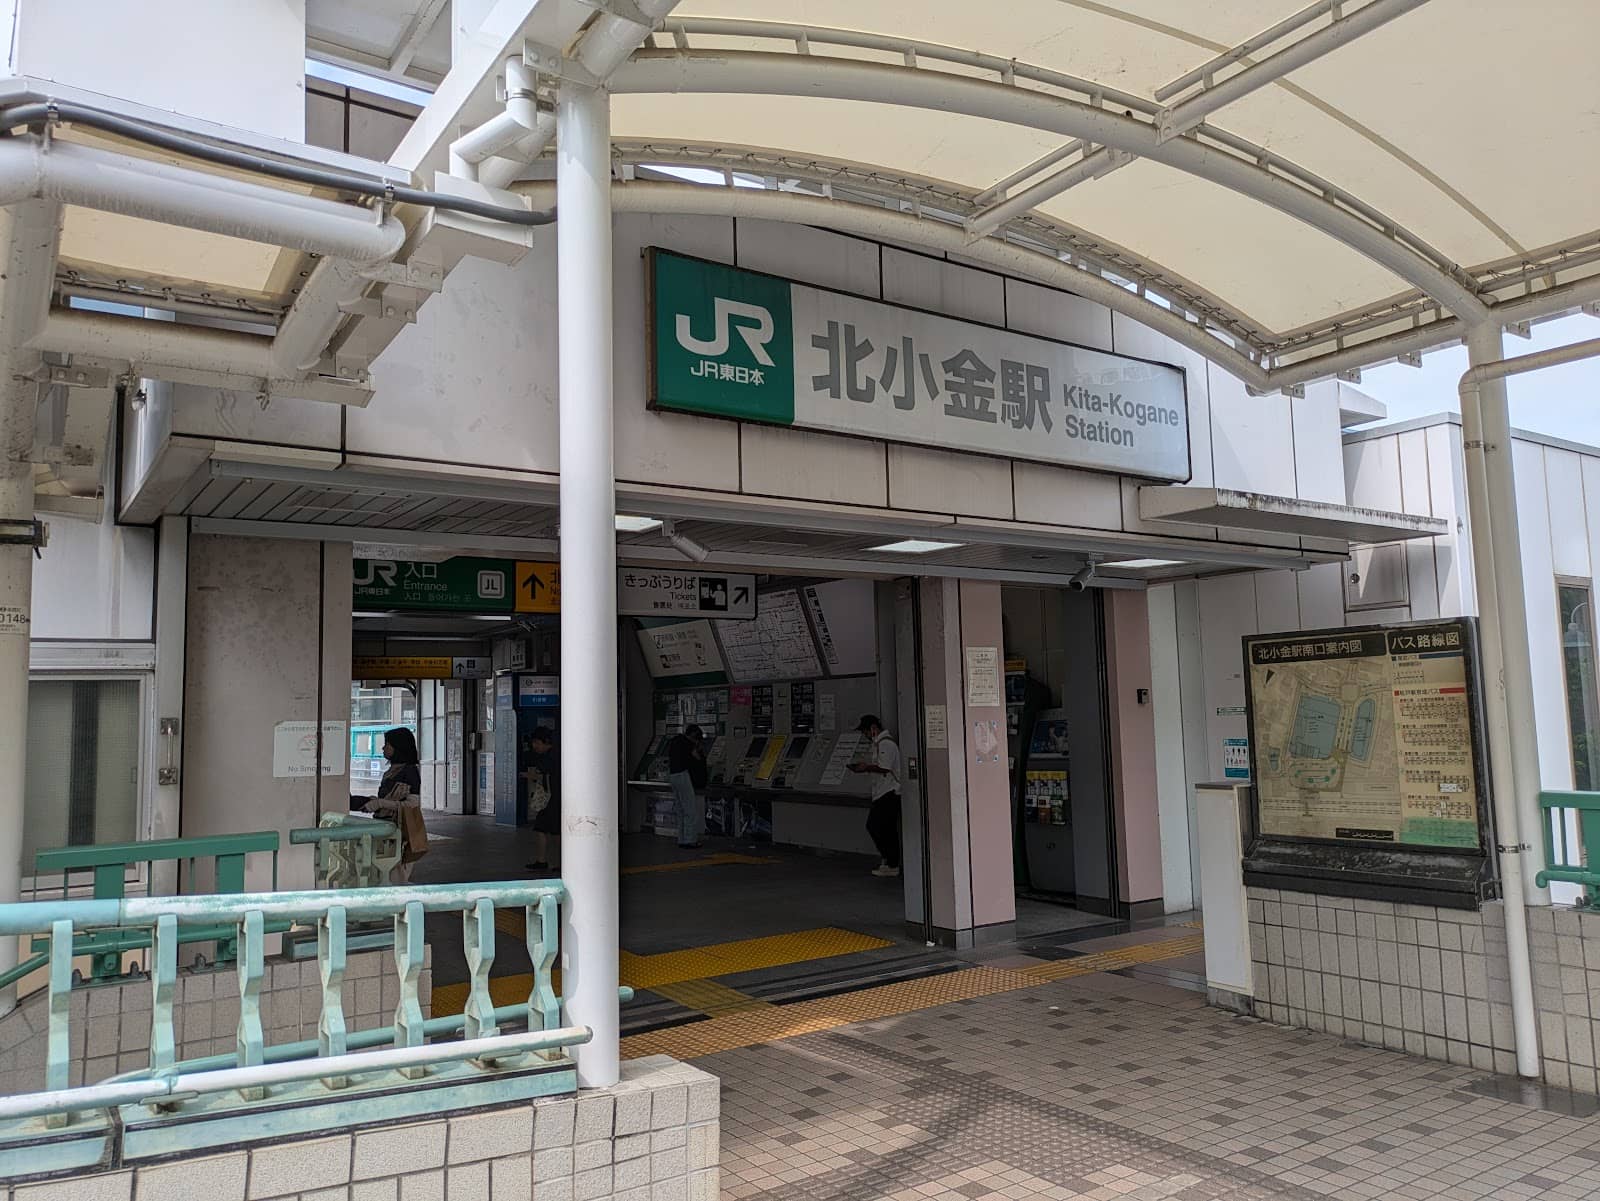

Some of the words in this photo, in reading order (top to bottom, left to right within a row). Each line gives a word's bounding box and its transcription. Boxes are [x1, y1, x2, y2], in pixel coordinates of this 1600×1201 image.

[675, 297, 775, 367] JR
[689, 364, 766, 387] JR東日本
[811, 320, 1054, 435] 北小金駅
[1063, 383, 1180, 428] Kita-Kogane
[1065, 414, 1135, 448] Station
[353, 559, 398, 587] JR
[404, 562, 437, 579] 入口
[403, 580, 448, 592] Entrance
[484, 578, 498, 591] JL
[624, 574, 697, 591] きっぷうりば
[670, 591, 697, 601] Tickets
[1258, 639, 1363, 660] 北小金駅南口案内図
[1391, 632, 1460, 650] バス路線図
